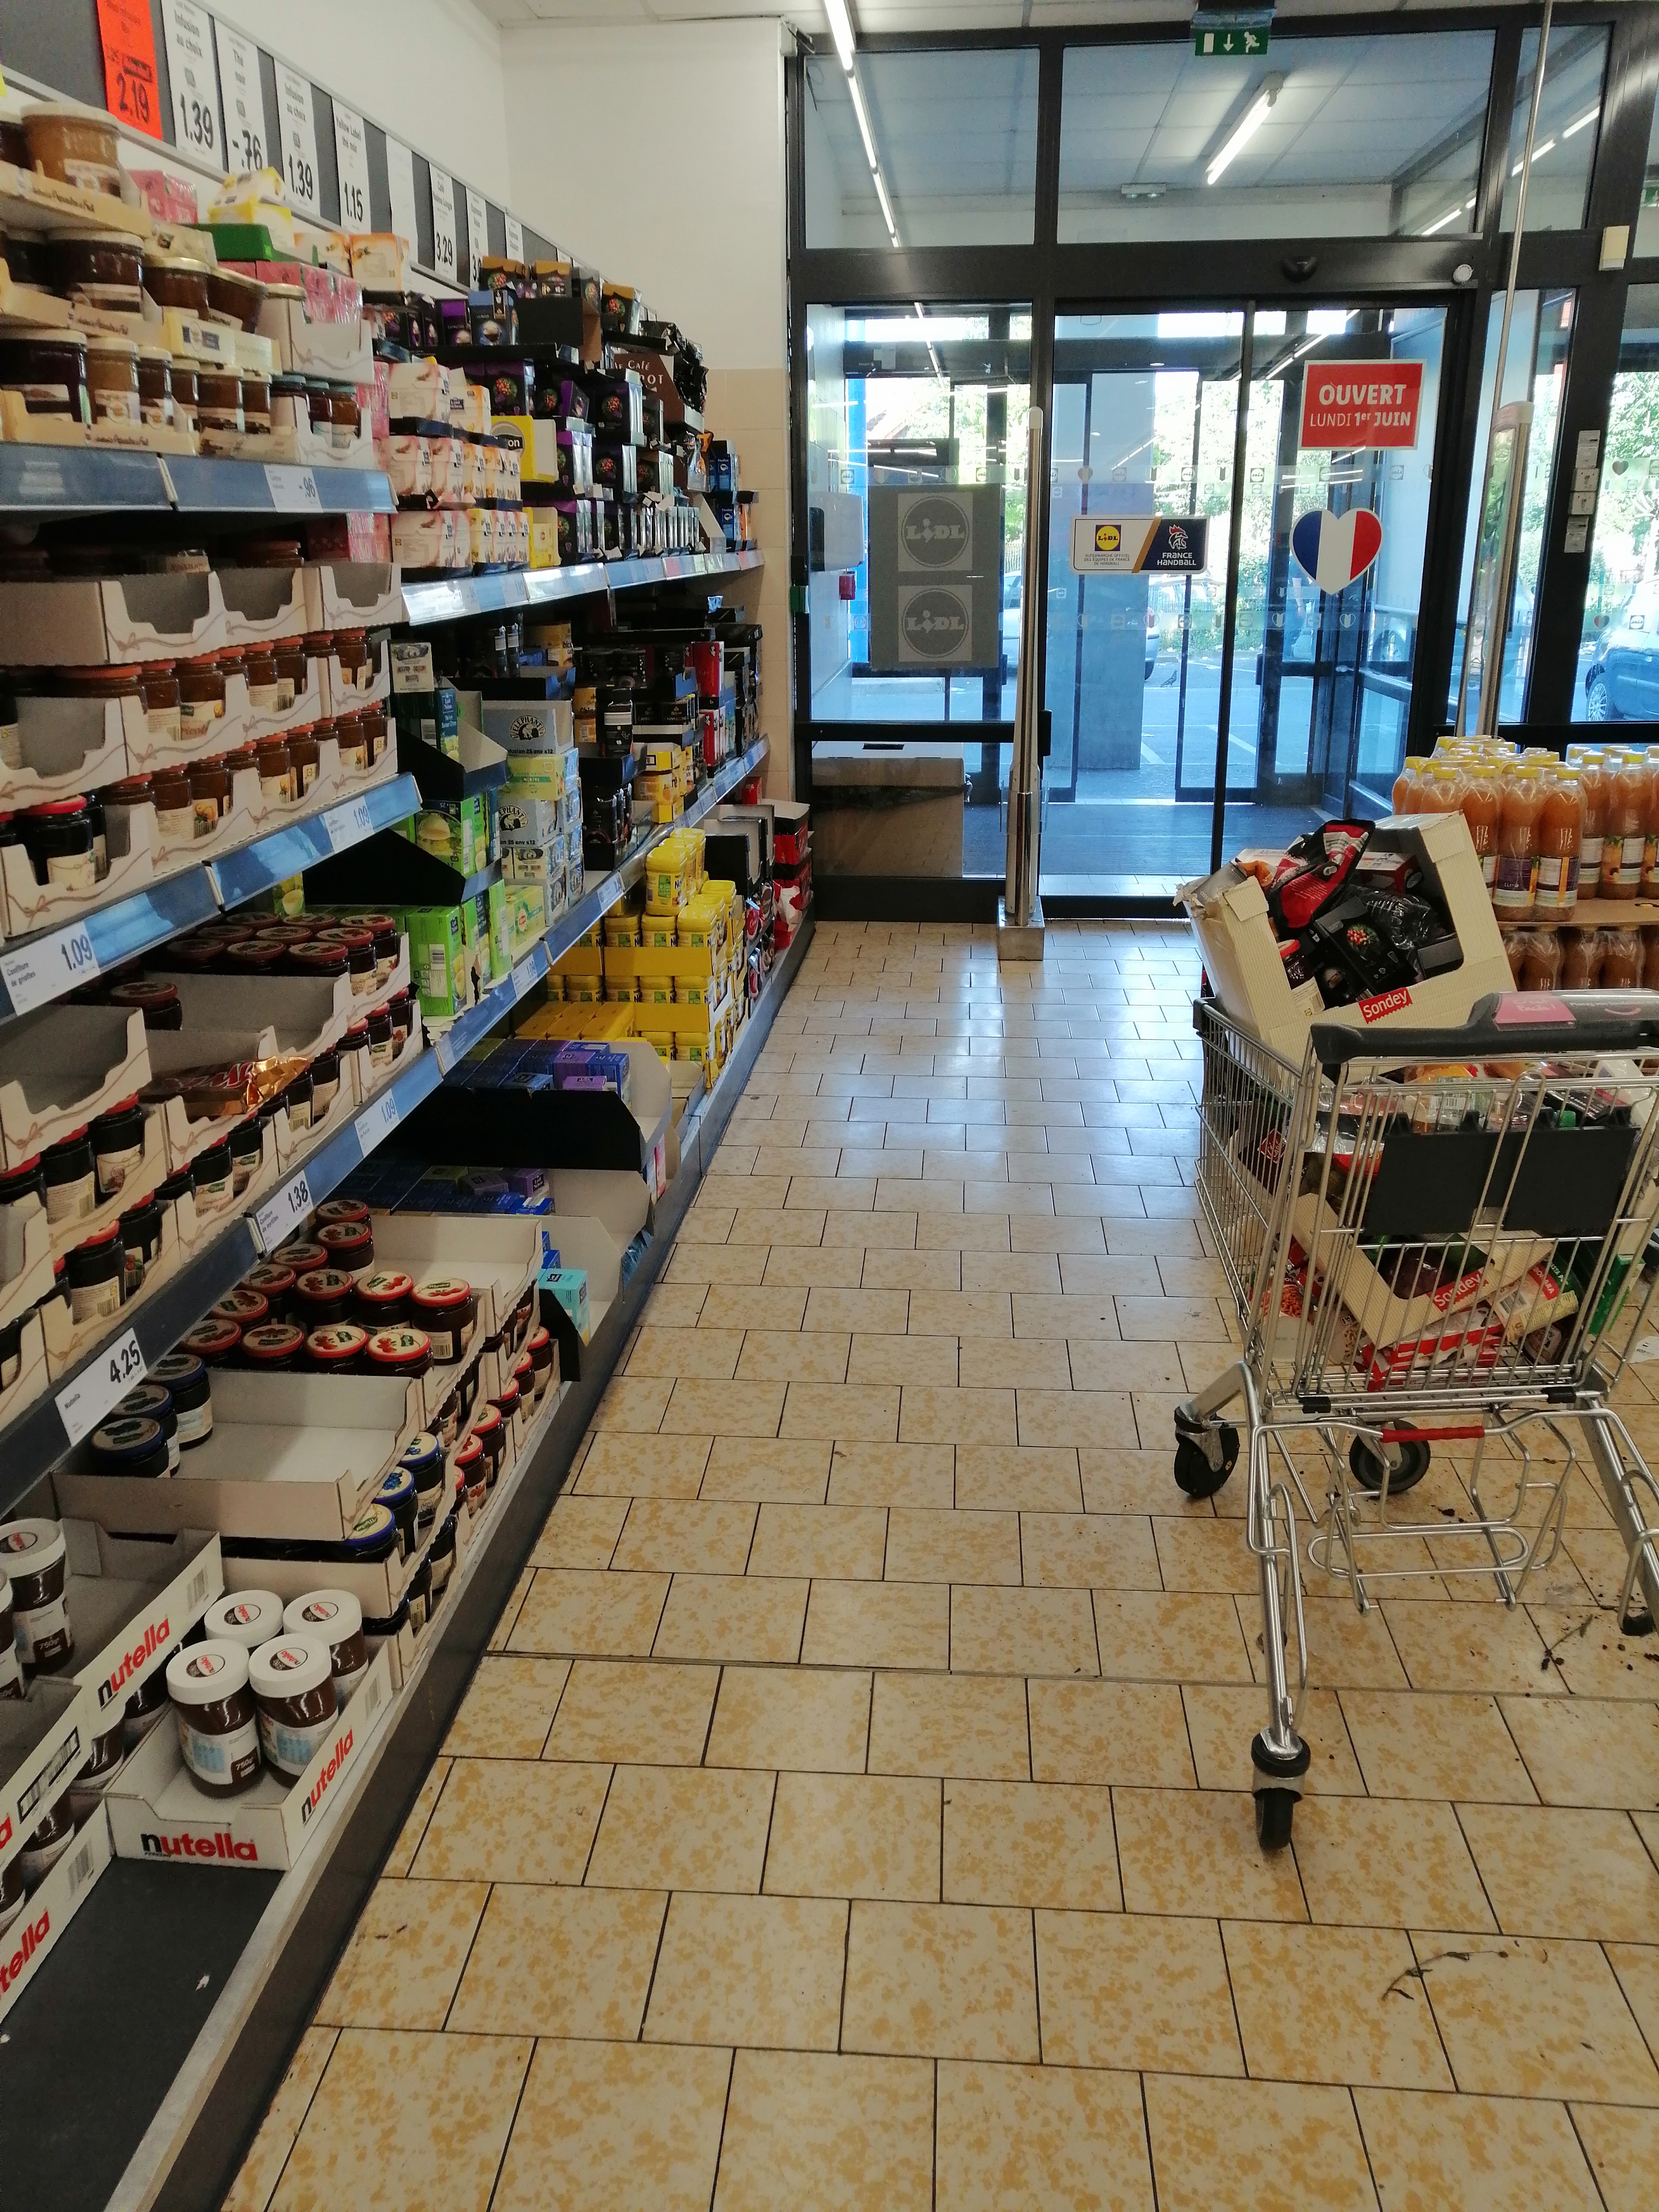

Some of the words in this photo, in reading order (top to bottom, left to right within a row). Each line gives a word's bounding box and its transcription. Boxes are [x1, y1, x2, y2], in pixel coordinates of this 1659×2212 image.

[174, 10, 200, 38] Infusion
[116, 72, 149, 124] 2.19
[284, 82, 304, 105] Infusion
[180, 92, 213, 149] 1.39
[334, 116, 350, 134] Yellow
[350, 129, 362, 142] Label
[288, 153, 313, 200] 1.39
[344, 180, 363, 222] 1.15
[436, 231, 452, 267] 3.29
[1319, 384, 1407, 405] OUVERT
[1310, 413, 1352, 427] LUNDI
[1354, 412, 1371, 426] 1er
[1373, 412, 1411, 426] JUIN
[906, 518, 965, 543] LIDL
[1097, 533, 1119, 541] LIDL
[906, 610, 965, 633] LIDL
[512, 715, 543, 731] ELEPHANT
[353, 805, 370, 830] 1.09
[61, 934, 92, 970] 1.09
[7, 962, 29, 976] Confiture
[1363, 990, 1407, 1018] Sondey
[381, 1098, 397, 1124] 1.09
[288, 1180, 308, 1214] 1.38
[260, 1210, 273, 1225] Confiture
[110, 1340, 140, 1383] 4.25
[64, 1393, 81, 1411] Nutella
[97, 1617, 170, 1708] nutella
[302, 1729, 354, 1824] nutella
[141, 1832, 258, 1862] nutella
